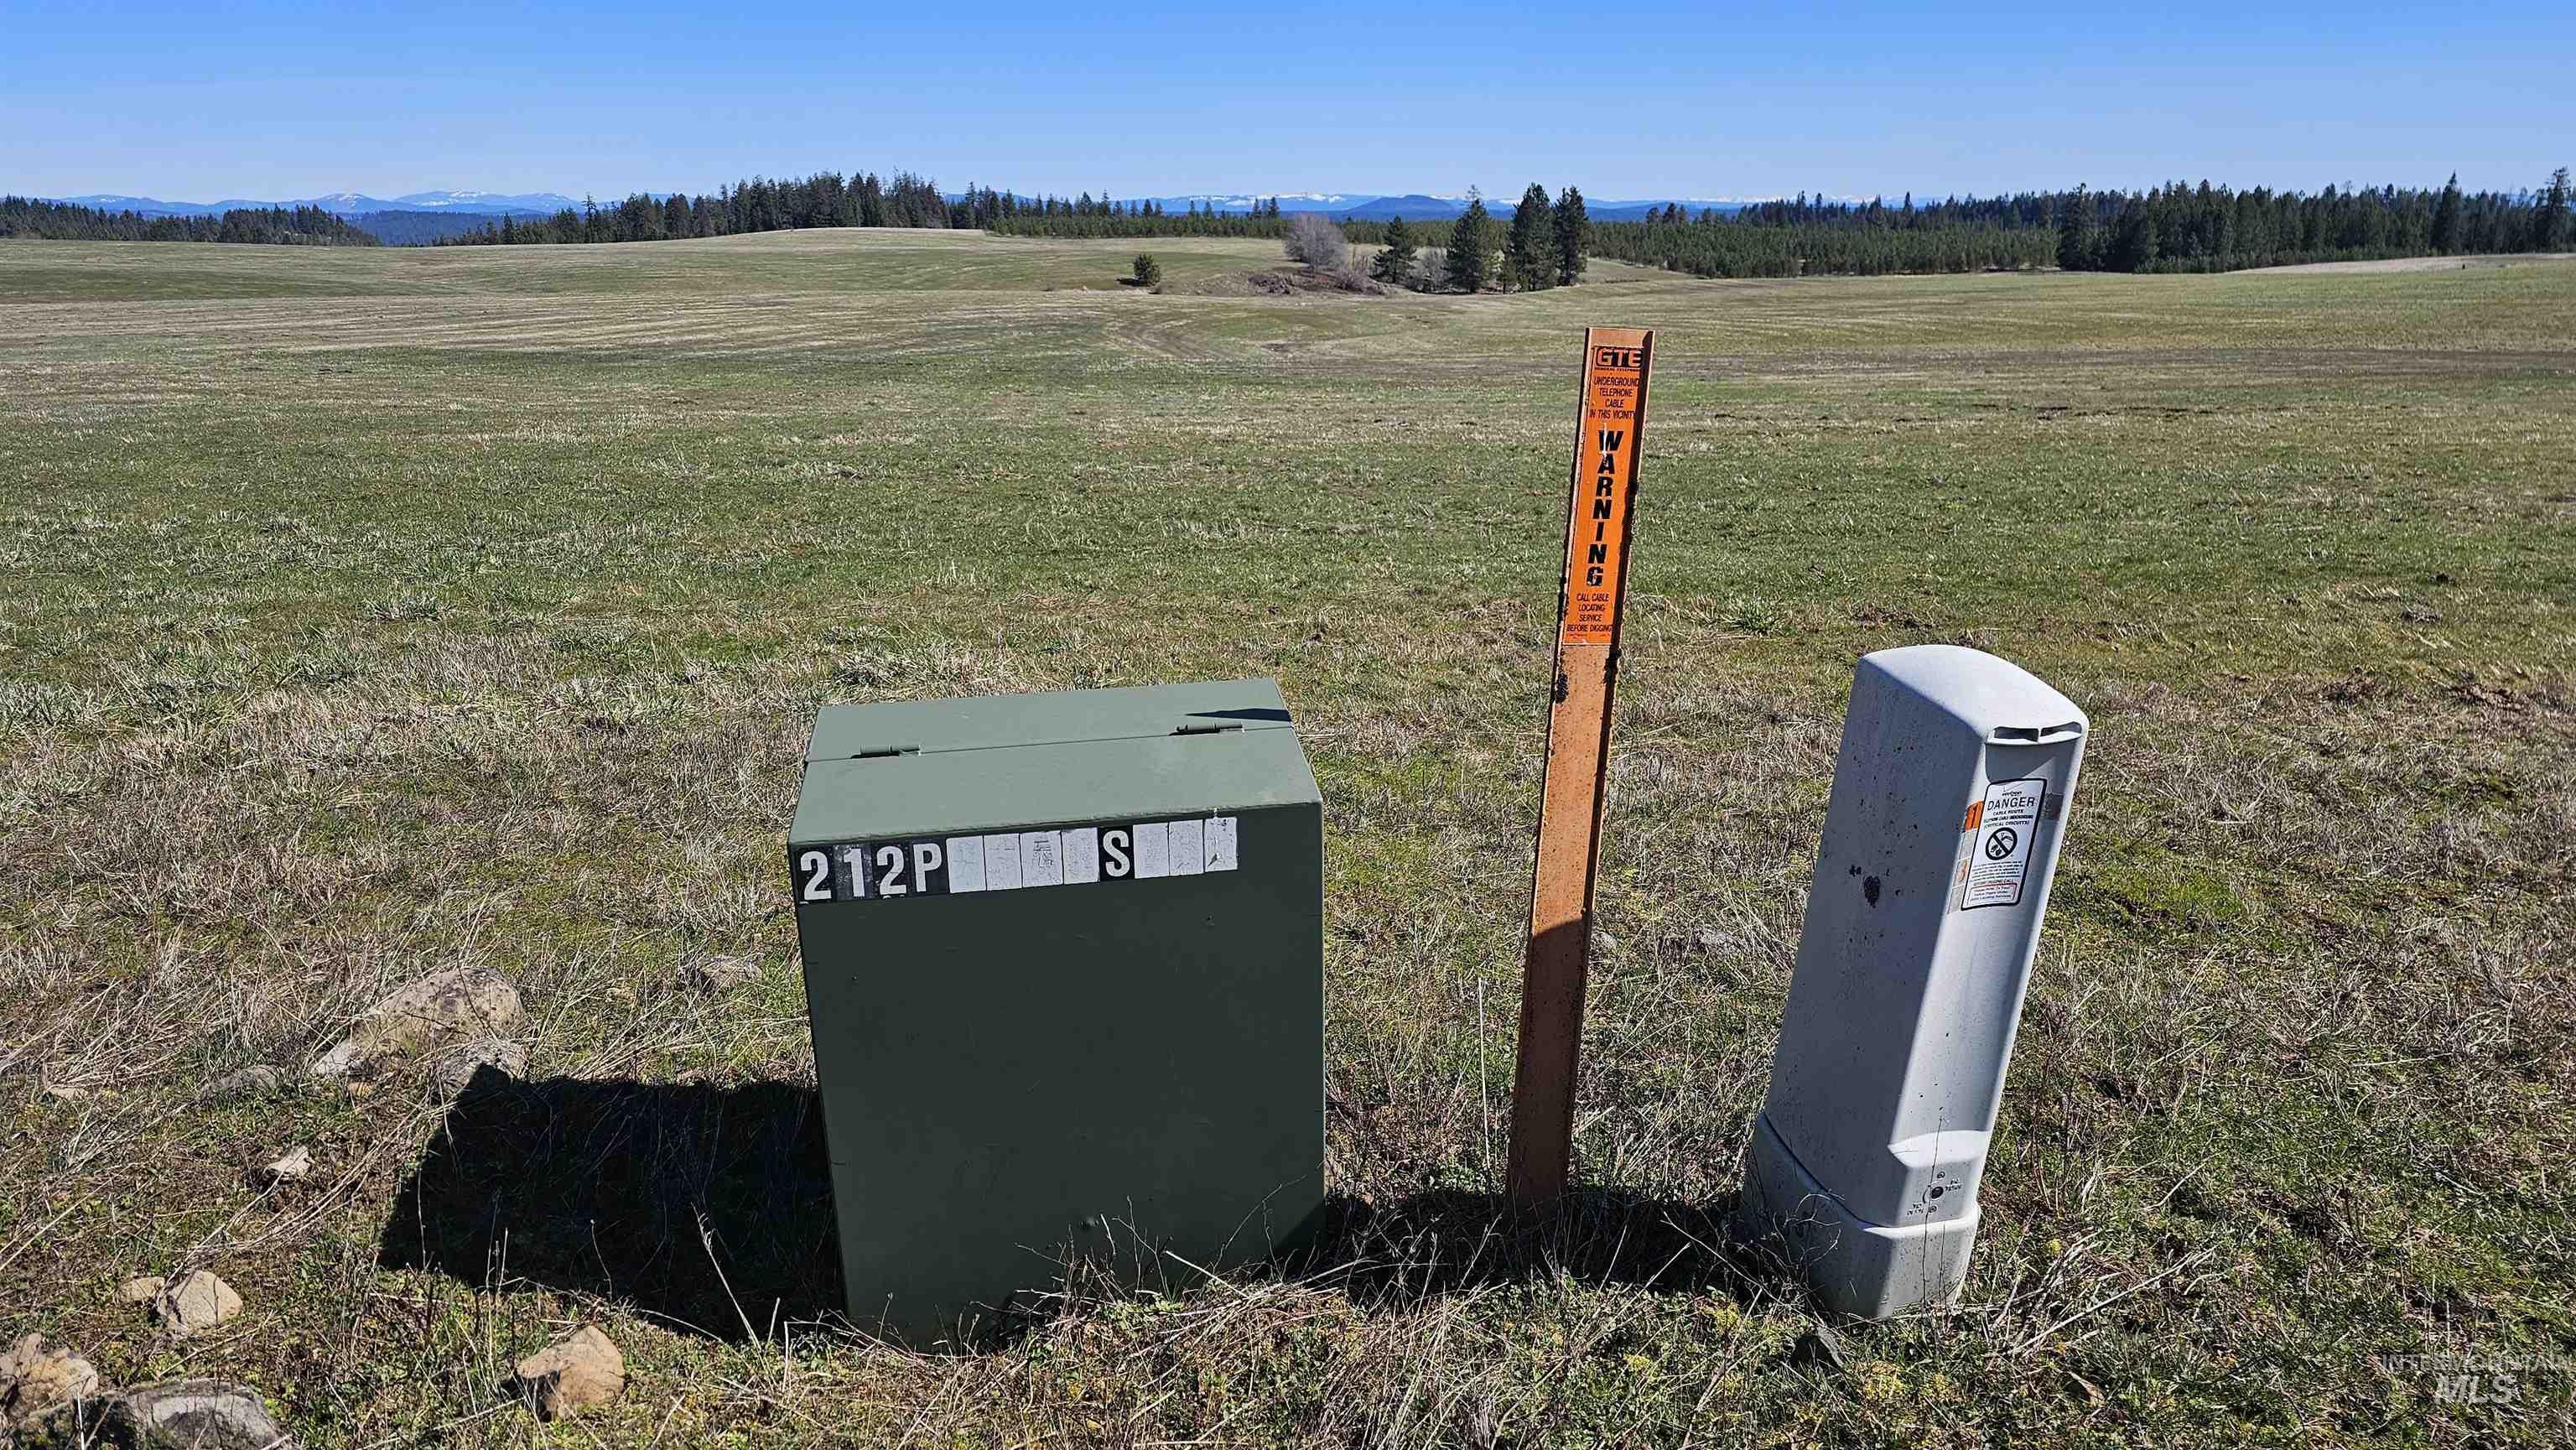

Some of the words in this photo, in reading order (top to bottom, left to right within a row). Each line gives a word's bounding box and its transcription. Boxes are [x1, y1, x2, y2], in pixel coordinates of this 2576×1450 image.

[1597, 348, 1642, 366] GTE
[1593, 377, 1640, 387] UNDERGROUND
[1599, 388, 1633, 397] TELEPHONE
[1605, 398, 1624, 408] CABLE
[1590, 409, 1597, 418] IN
[1598, 409, 1611, 418] THIS
[1587, 429, 1624, 587] WARNING
[1576, 593, 1591, 601] CALL
[1592, 593, 1609, 602] CABLE
[1578, 603, 1606, 611] LOCATING
[1579, 614, 1602, 622] SERVICE
[1566, 624, 1588, 632] BEFORE
[1589, 624, 1613, 632] DIGGING
[1987, 797, 2035, 811] DANGER
[798, 842, 943, 902] 212P
[1102, 829, 1132, 877] S
